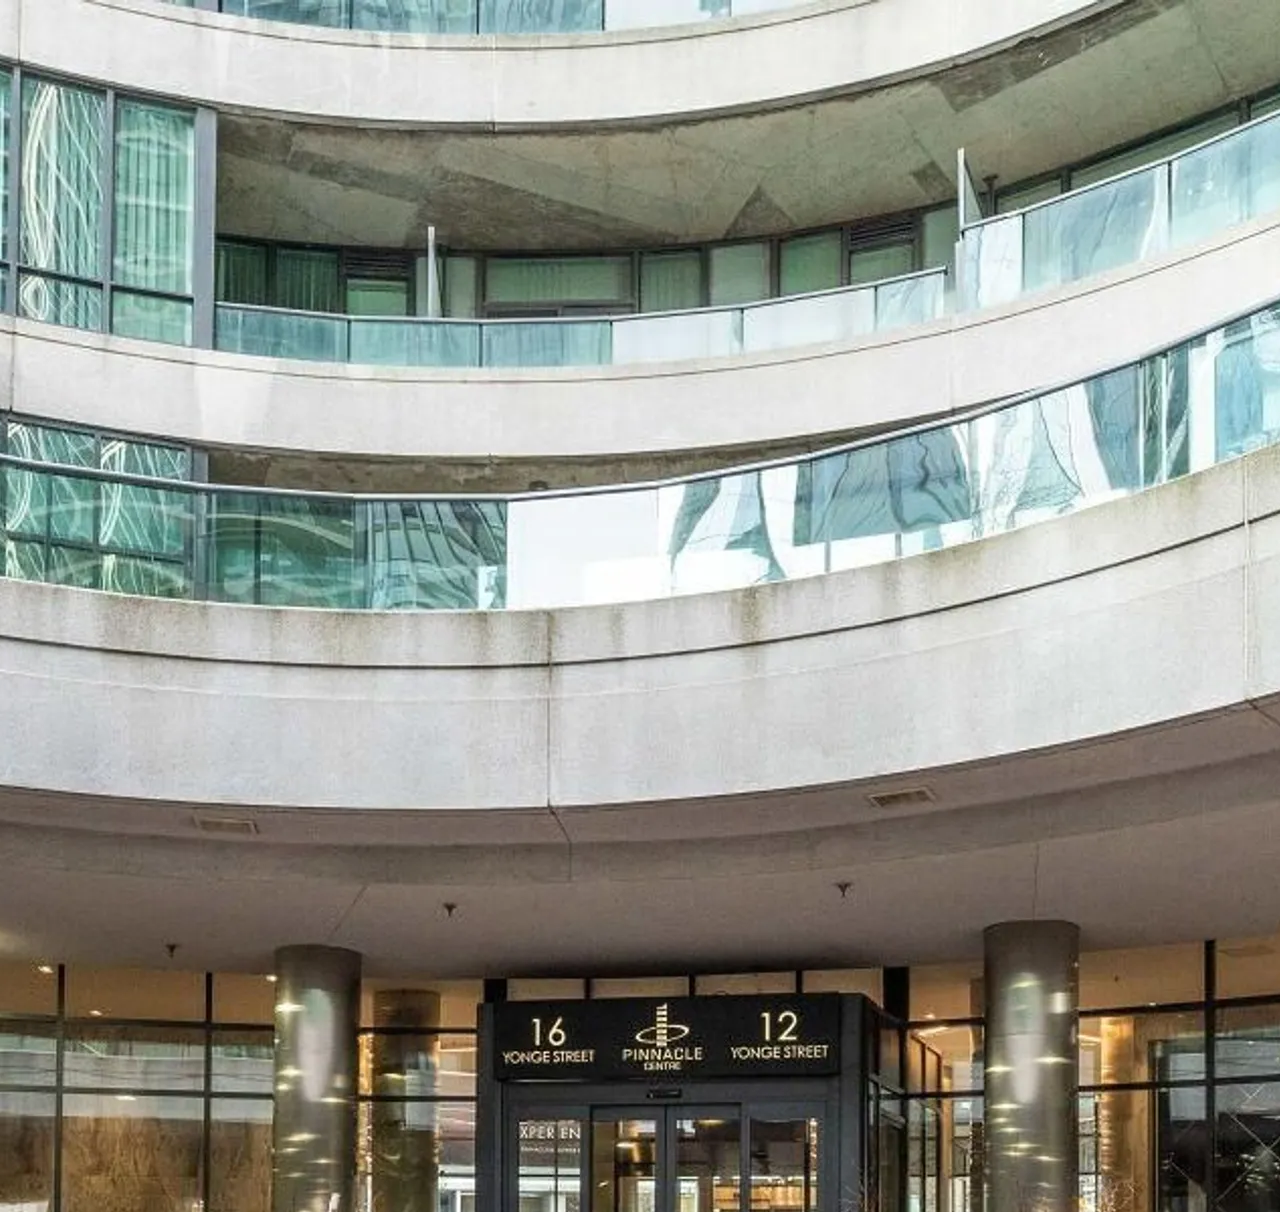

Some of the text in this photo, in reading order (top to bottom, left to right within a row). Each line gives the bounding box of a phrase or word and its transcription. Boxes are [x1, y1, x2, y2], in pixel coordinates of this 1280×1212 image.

[531, 1016, 566, 1047] 16
[760, 1010, 798, 1042] 12
[503, 1049, 595, 1065] YONGE STREET
[622, 1047, 703, 1061] PINNACLE
[730, 1044, 829, 1060] YONGE STREET
[644, 1062, 682, 1071] CENTRE
